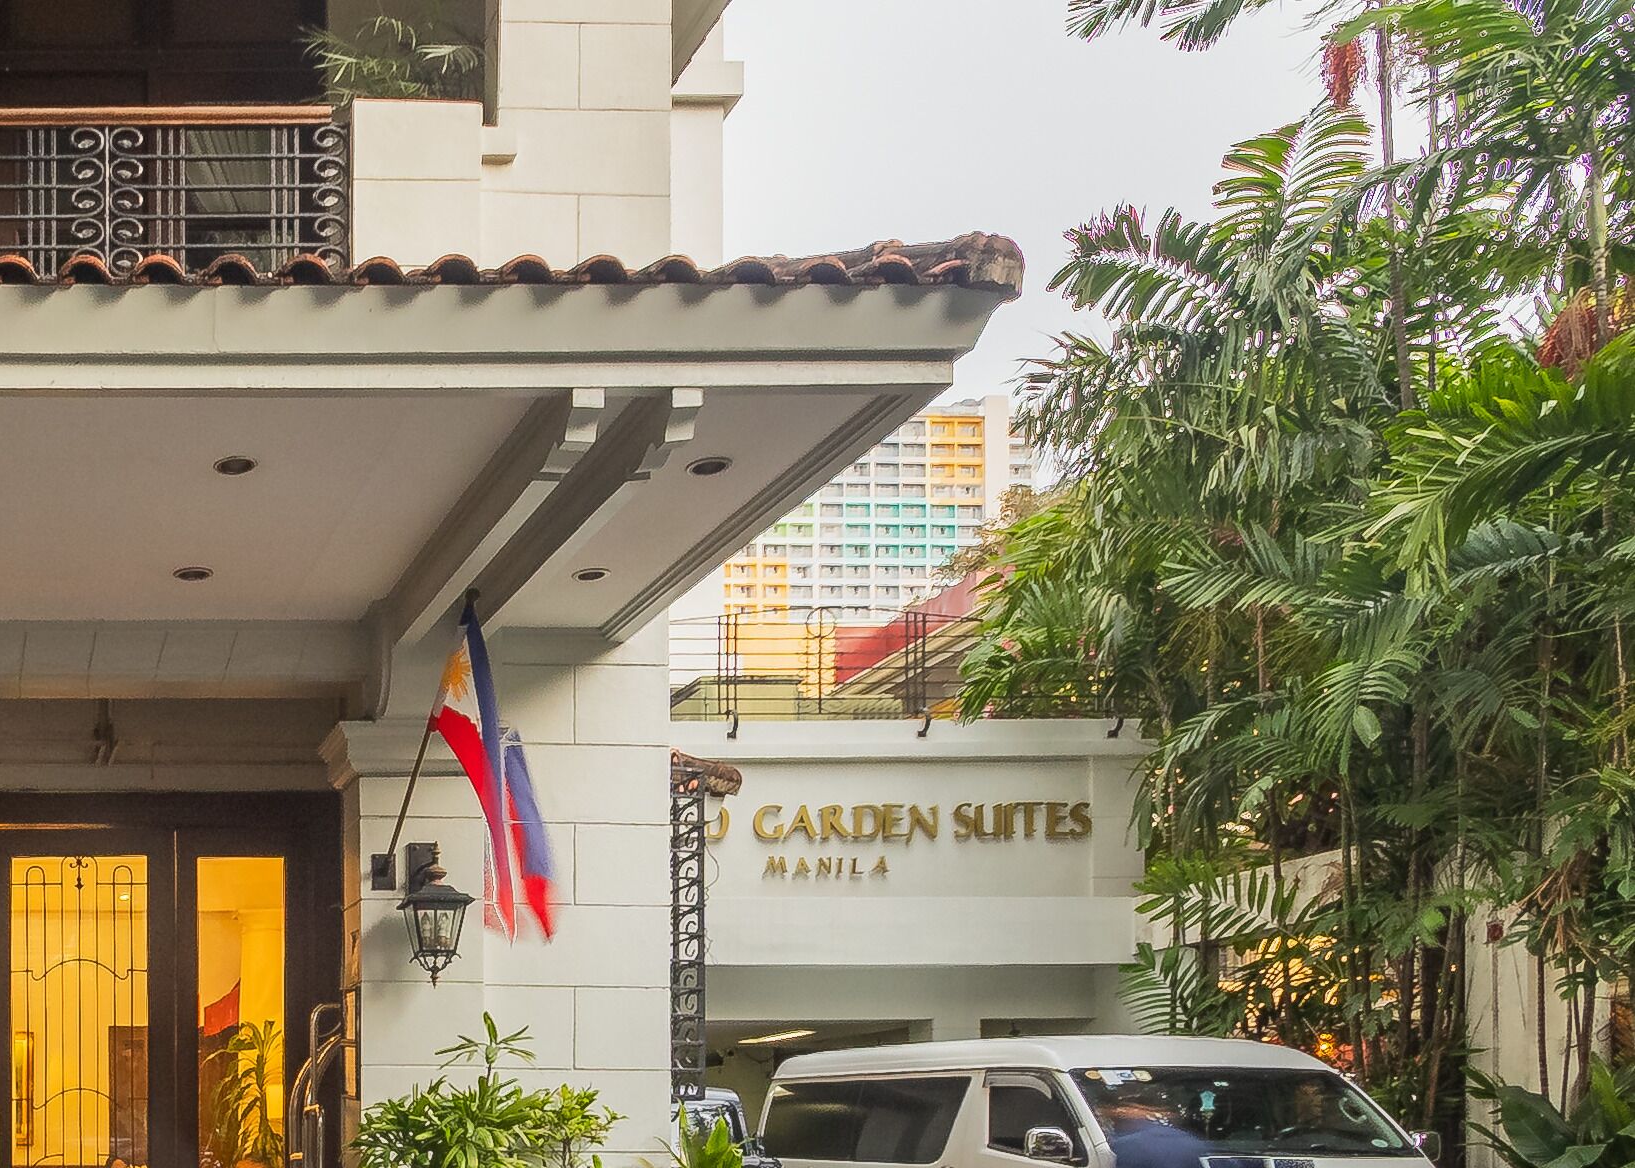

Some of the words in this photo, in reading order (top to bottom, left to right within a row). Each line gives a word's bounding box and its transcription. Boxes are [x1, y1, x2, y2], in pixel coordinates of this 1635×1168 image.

[752, 803, 939, 844] GARDEN
[953, 801, 1093, 839] SUITES
[764, 855, 890, 876] MANILA
